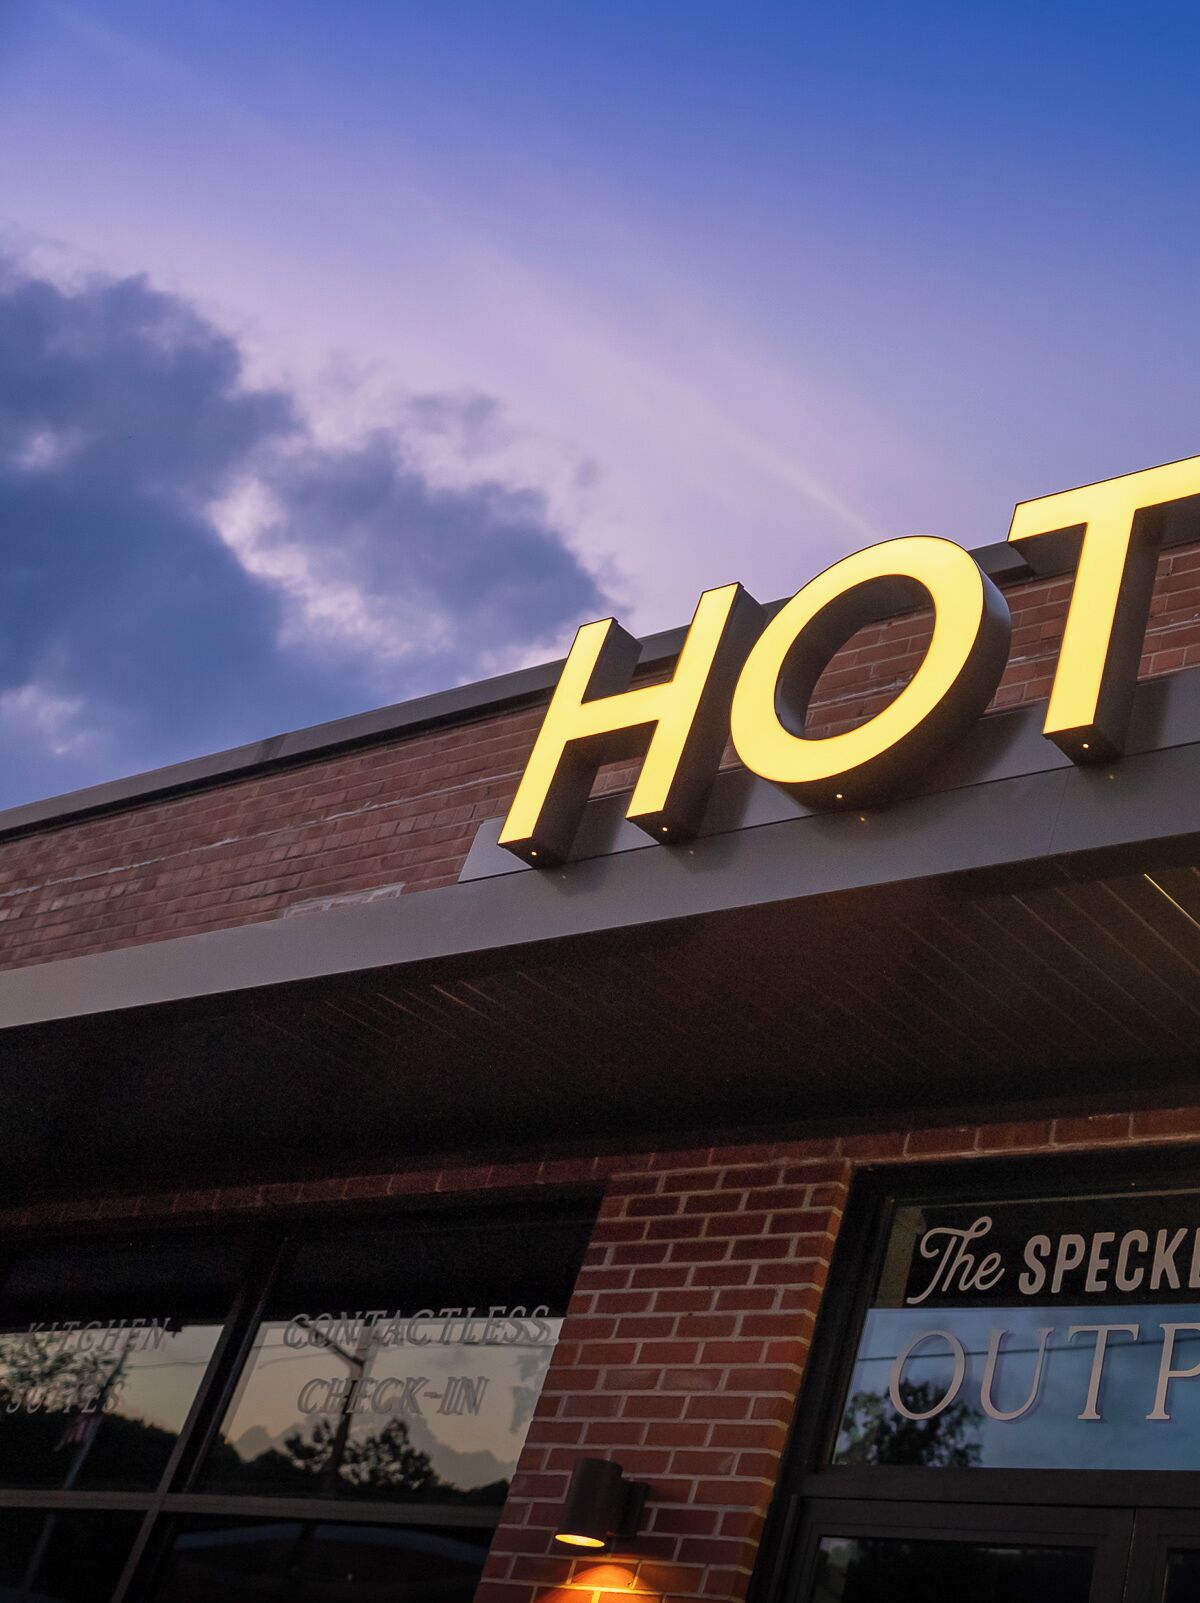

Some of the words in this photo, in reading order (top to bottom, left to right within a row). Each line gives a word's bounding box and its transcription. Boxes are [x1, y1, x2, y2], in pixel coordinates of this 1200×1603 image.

[906, 1215, 1005, 1304] The
[22, 1317, 171, 1351] KITCHEN
[283, 1305, 551, 1348] CONTACTLESS
[297, 1376, 490, 1416] CHECK-IN
